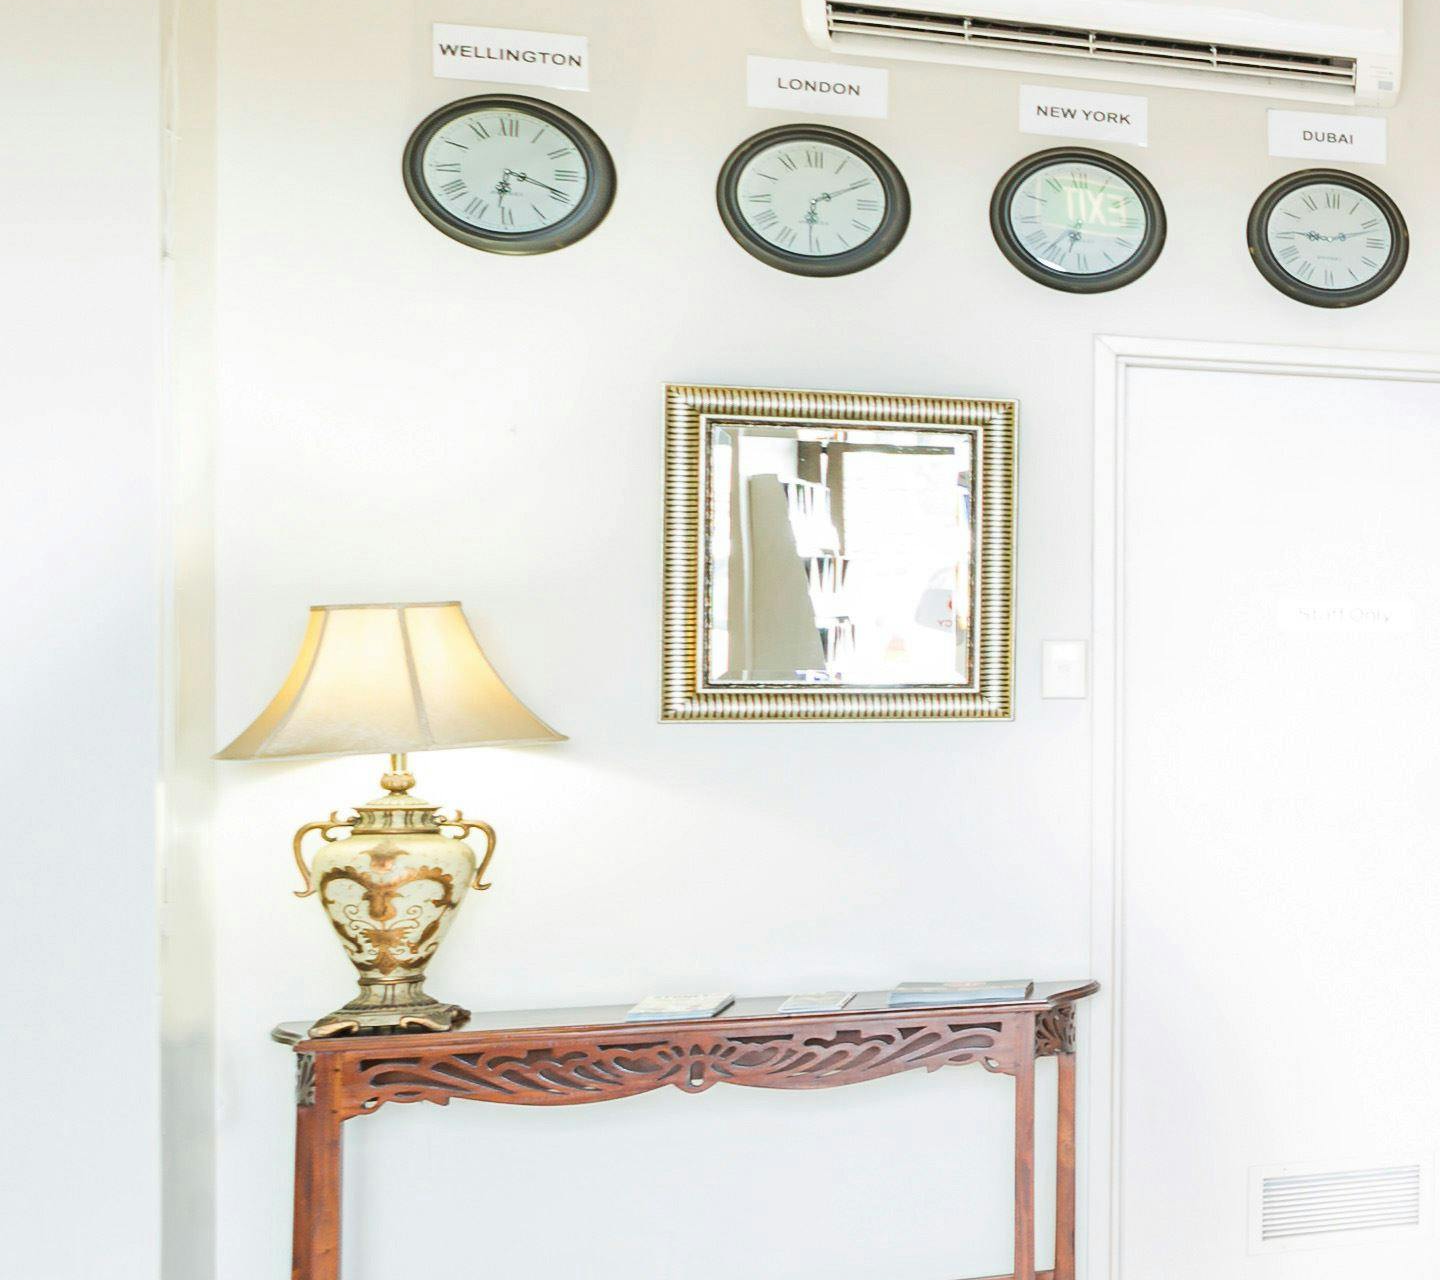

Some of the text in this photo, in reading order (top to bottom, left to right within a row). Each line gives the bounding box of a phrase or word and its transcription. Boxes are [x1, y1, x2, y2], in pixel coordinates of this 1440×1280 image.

[439, 42, 583, 69] WELLINGTON
[777, 75, 861, 97] LONDON
[1036, 103, 1132, 126] NEW YORK
[1302, 128, 1354, 146] DUBAI
